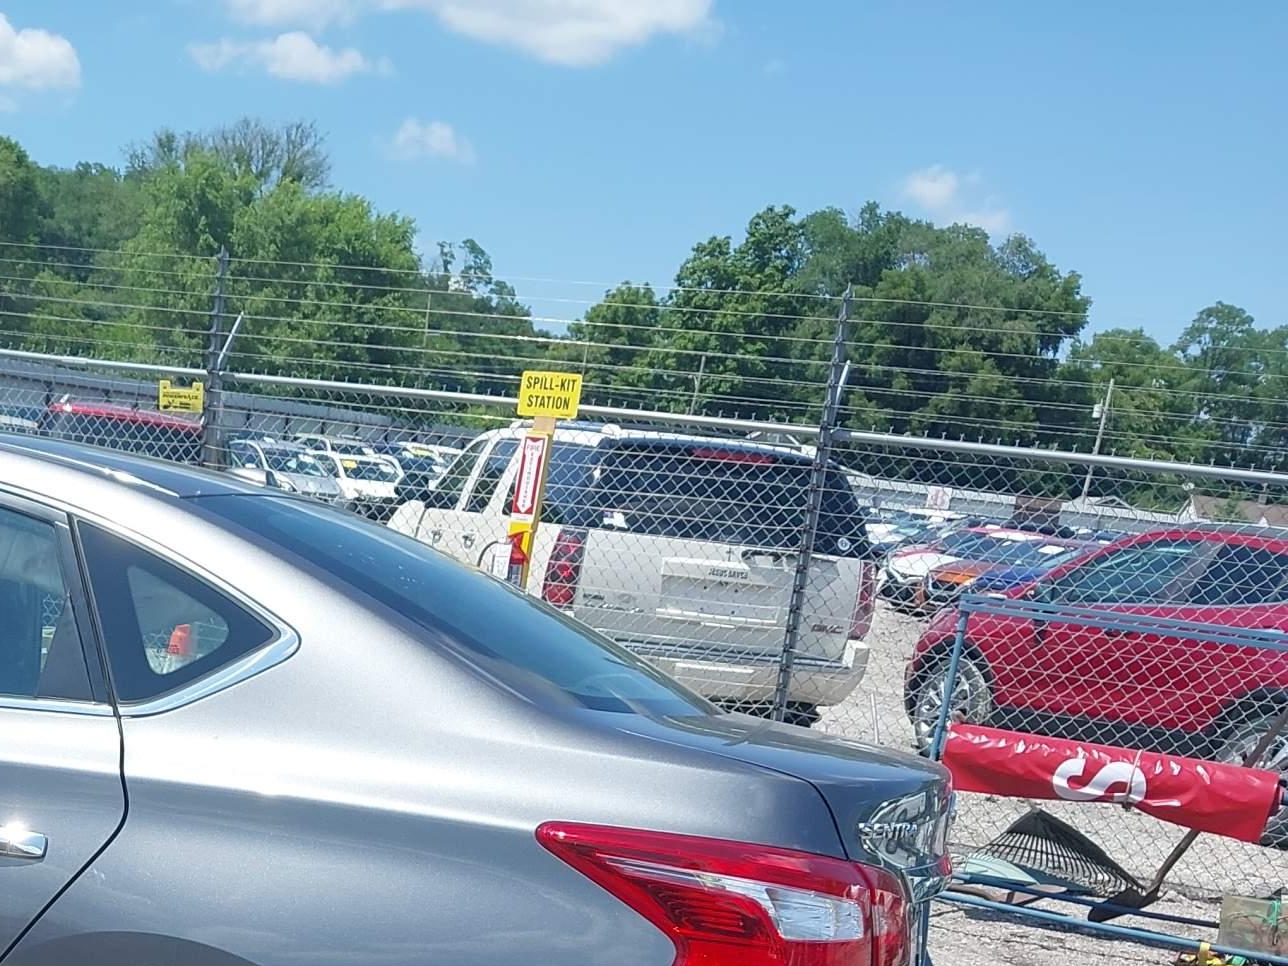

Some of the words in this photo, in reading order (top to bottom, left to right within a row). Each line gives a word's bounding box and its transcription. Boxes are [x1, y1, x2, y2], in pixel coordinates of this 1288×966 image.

[526, 375, 577, 393] SPILL-KIT
[527, 394, 571, 410] STATION
[858, 822, 918, 840] SENTRA
